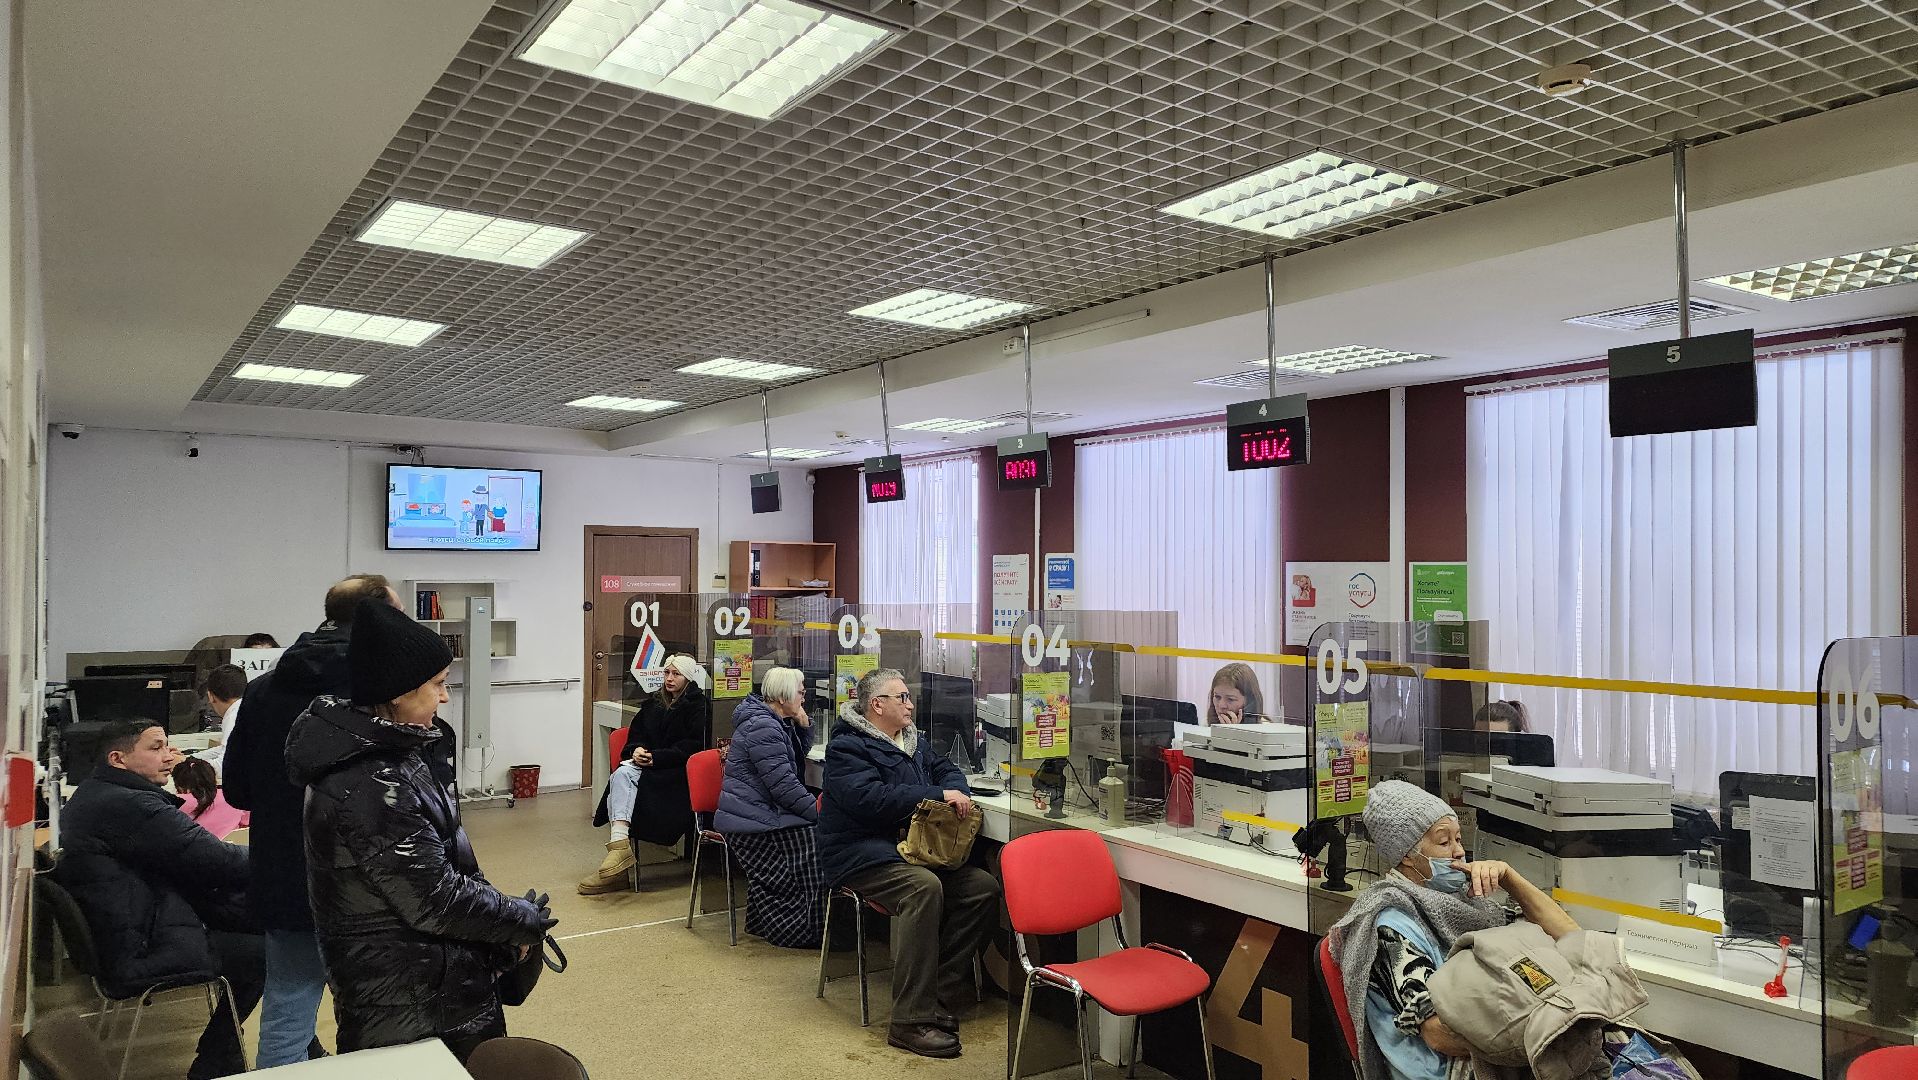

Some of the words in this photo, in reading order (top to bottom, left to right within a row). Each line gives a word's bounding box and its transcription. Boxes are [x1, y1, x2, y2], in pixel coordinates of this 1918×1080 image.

[1666, 345, 1681, 363] 5
[1258, 403, 1268, 417] 4
[1017, 438, 1024, 449] 3
[878, 458, 884, 468] 2
[603, 579, 620, 589] 108
[1417, 580, 1440, 588] Хотите?
[630, 601, 660, 628] 01
[713, 606, 752, 636] 02
[837, 613, 882, 649] 03
[1021, 623, 1071, 667] 04
[237, 659, 270, 671] ЗАГ
[1316, 638, 1368, 695] 05
[1828, 664, 1880, 743] 06
[1627, 929, 1668, 944] Технический
[1205, 917, 1309, 1080] 4
